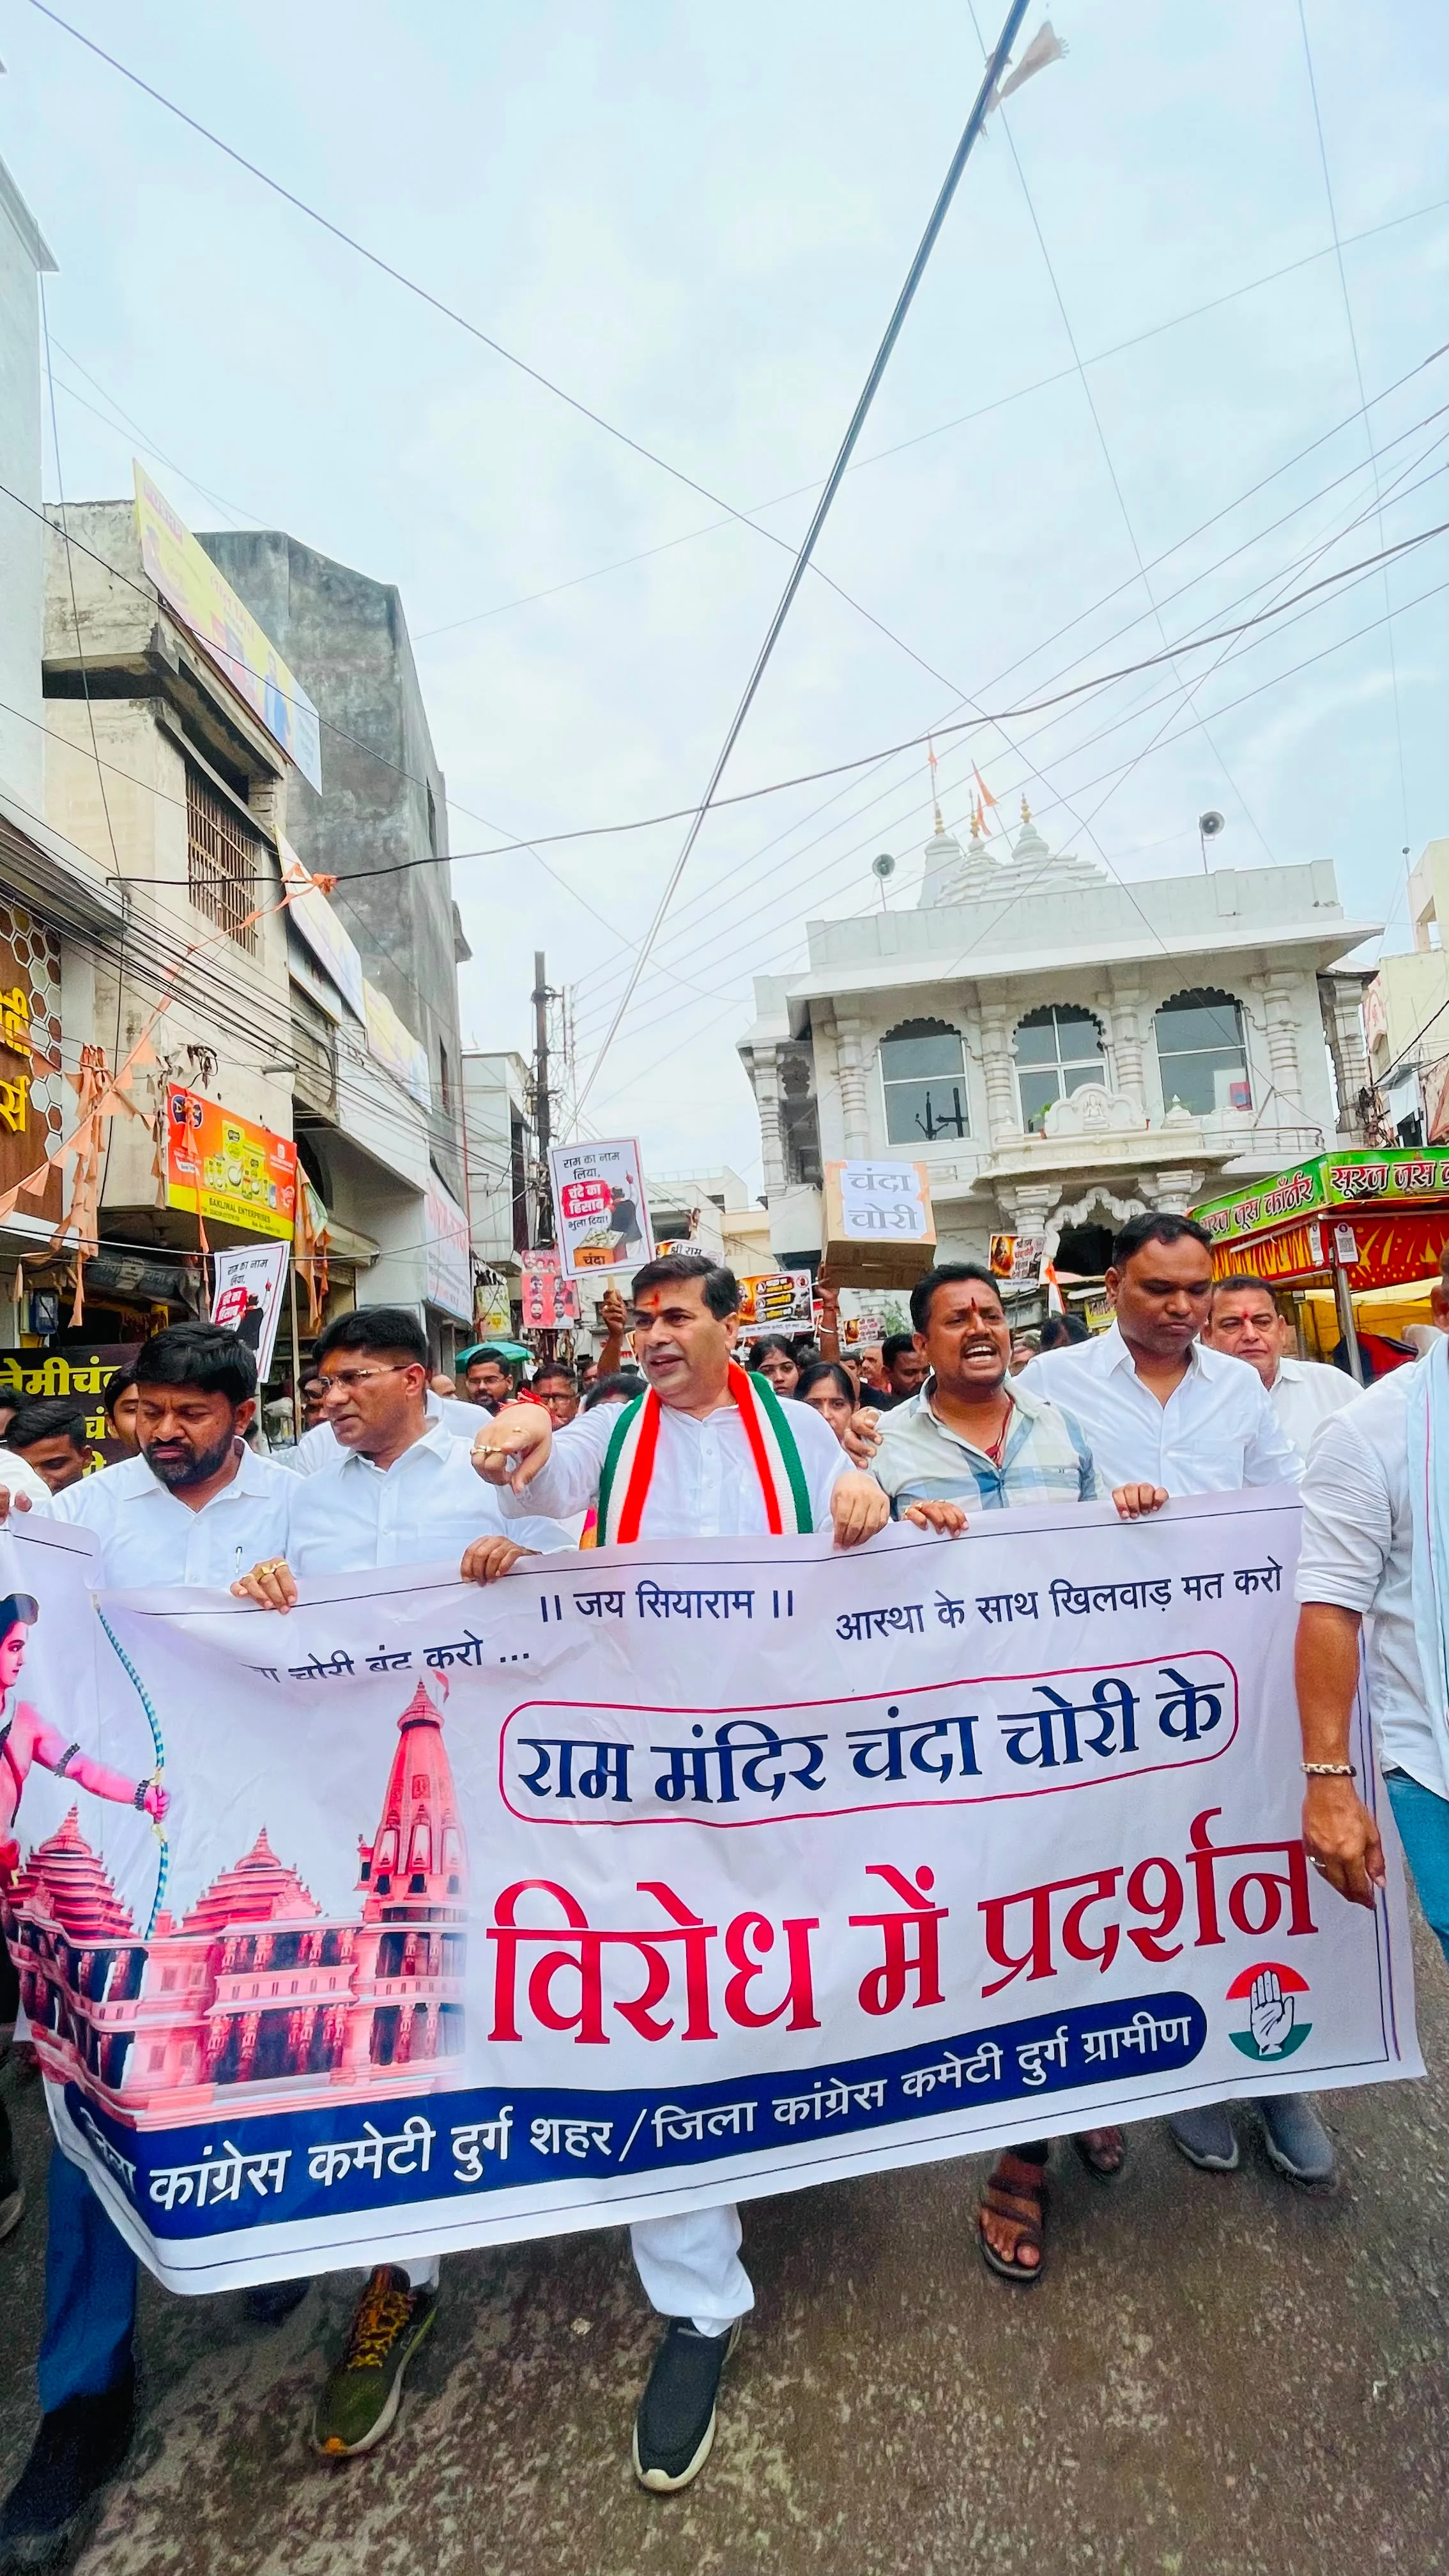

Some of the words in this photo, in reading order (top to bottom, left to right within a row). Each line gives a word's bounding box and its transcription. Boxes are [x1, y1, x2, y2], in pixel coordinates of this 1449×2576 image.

[563, 1156, 581, 1169] राम
[584, 1154, 595, 1164] का
[598, 1152, 620, 1162] नाम
[585, 1183, 602, 1196] का
[847, 1168, 912, 1192] चंदा
[1330, 1163, 1389, 1199] सूरज
[569, 1198, 605, 1215] हिसाब
[848, 1203, 918, 1230] चोरी
[568, 1218, 586, 1231] भुला
[250, 1259, 268, 1269] नाम
[582, 1252, 605, 1266] चंदा
[685, 1246, 702, 1256] राम
[0, 1356, 123, 1396] नेमीचं
[573, 1591, 625, 1618] जय
[635, 1579, 755, 1619] सियाराम
[836, 1605, 924, 1641] आस्था
[934, 1590, 965, 1629] के
[976, 1591, 1038, 1624] साथ
[1048, 1578, 1172, 1618] खिलवाड़
[1181, 1572, 1225, 1602] मत
[1234, 1555, 1284, 1595] करो
[288, 1650, 355, 1681] चोरी
[423, 1629, 484, 1671] करो
[518, 1738, 634, 1802] राम
[650, 1720, 828, 1804] मंदिर
[846, 1705, 983, 1784] चंदा
[997, 1678, 1140, 1768] चोरी
[1155, 1667, 1225, 1742] के
[486, 1878, 822, 2044] विरोध
[848, 1864, 949, 2016] में
[977, 1807, 1319, 1999] प्रदर्शन
[149, 2140, 293, 2211] कांग्रेस
[307, 2115, 437, 2186] कमेटी
[450, 2106, 514, 2182] दुर्ग
[772, 2077, 888, 2126] कांग्रेस
[901, 2042, 1004, 2099] कमेटी
[1015, 2026, 1070, 2087] दुर्ग
[1081, 2011, 1192, 2065] ग्रामीण
